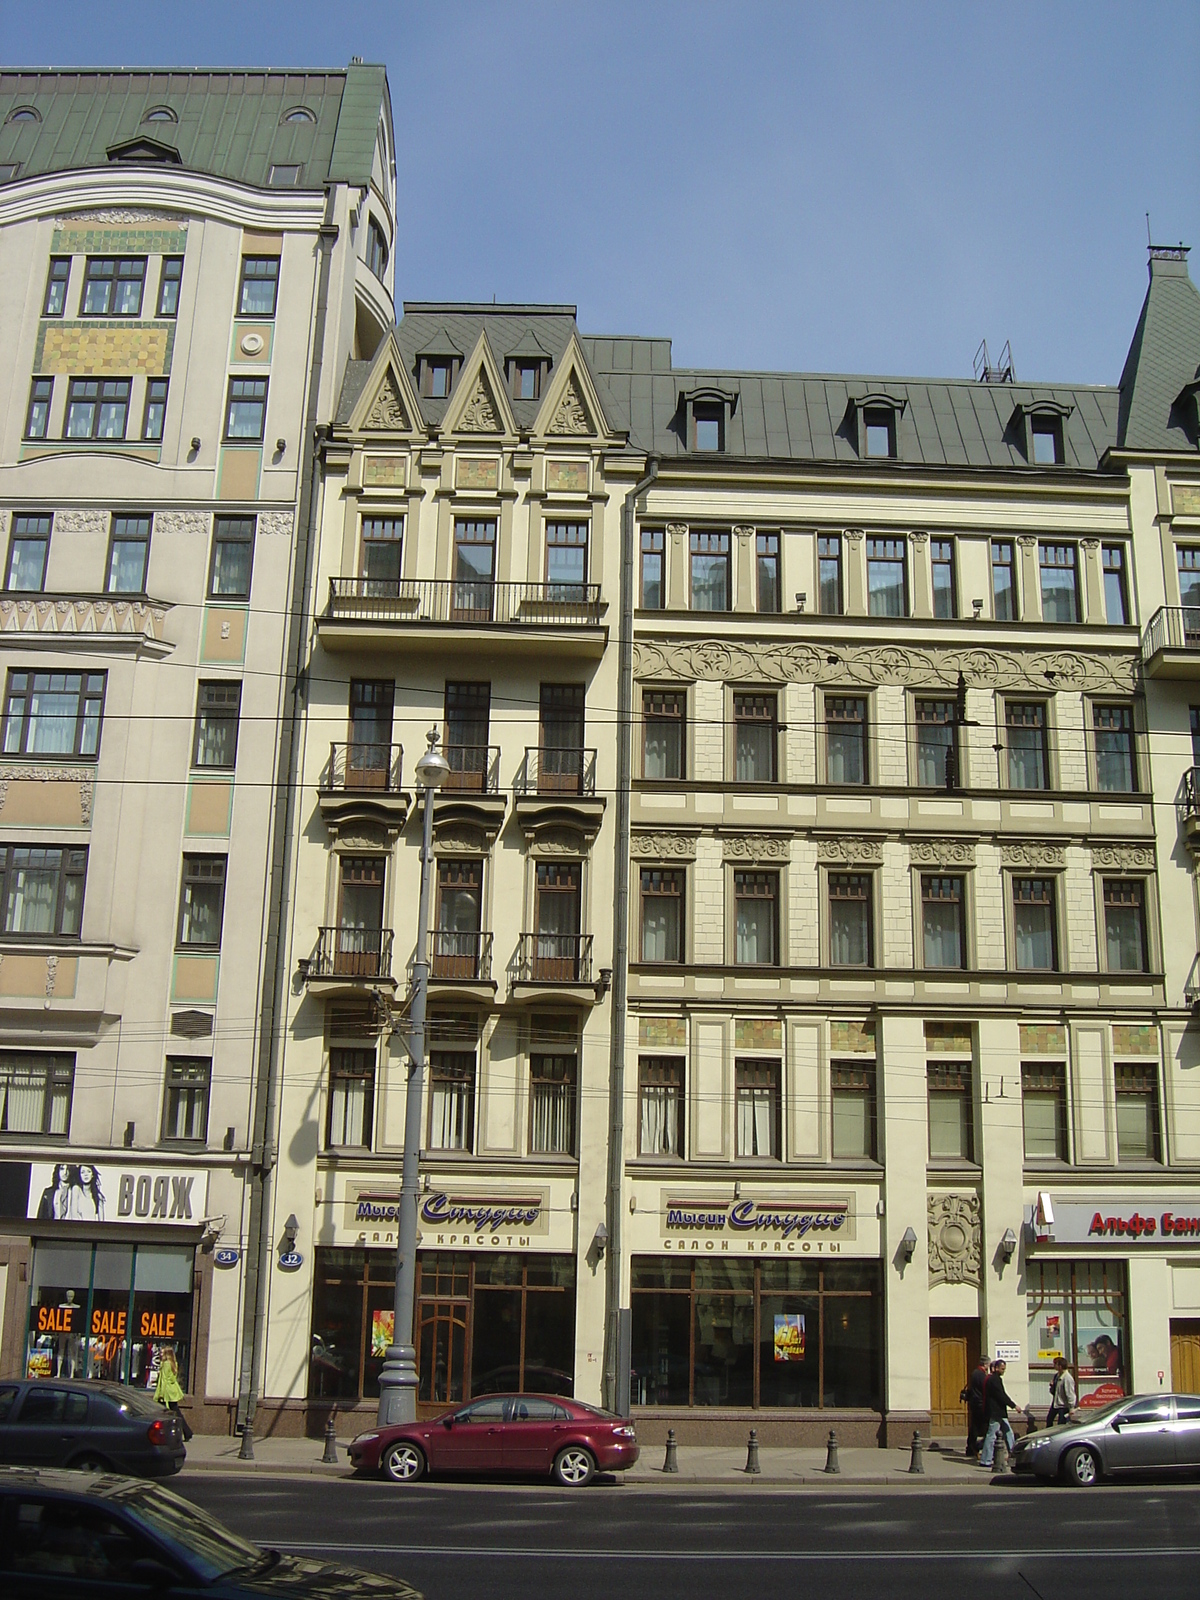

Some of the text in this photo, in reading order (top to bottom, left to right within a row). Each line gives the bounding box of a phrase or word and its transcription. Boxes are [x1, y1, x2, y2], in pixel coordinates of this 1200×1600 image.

[117, 1174, 195, 1219] ВОЯЖ
[357, 1193, 540, 1229] Мыс Студио
[667, 1200, 846, 1236] Мысин Студио
[1091, 1212, 1156, 1235] Альфа
[358, 1232, 530, 1246] САЛ КРАСОТЫ
[664, 1240, 841, 1252] САЛОН КРАСОТЫ
[220, 1252, 232, 1261] 34
[285, 1254, 298, 1264] 32
[38, 1306, 73, 1332] SALE
[92, 1310, 127, 1335] SALE
[140, 1312, 175, 1336] SALE
